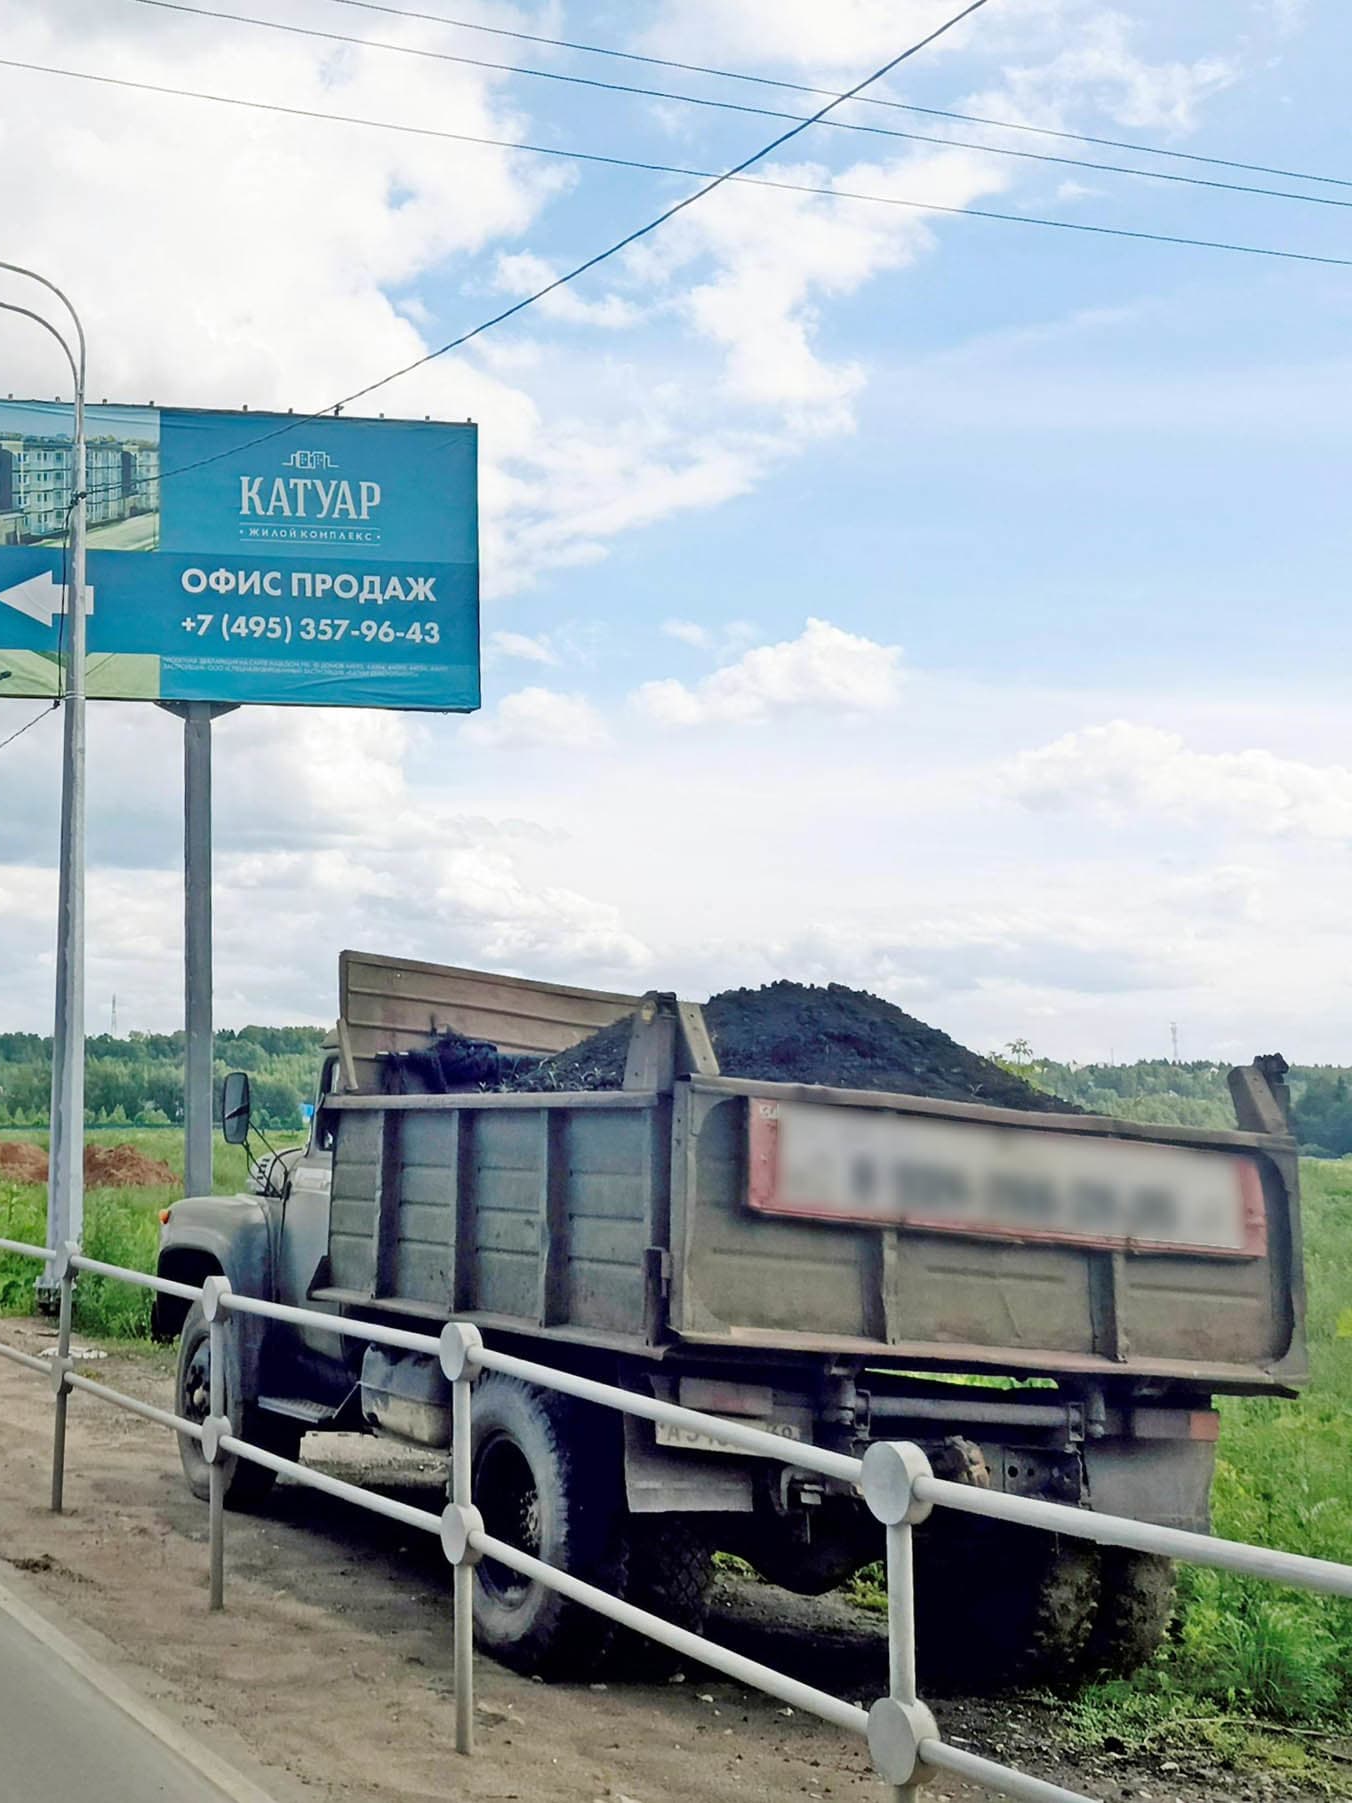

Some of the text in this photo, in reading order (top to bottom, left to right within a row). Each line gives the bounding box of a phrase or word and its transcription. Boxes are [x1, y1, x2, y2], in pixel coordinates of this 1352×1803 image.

[239, 475, 382, 520] КАТУАР
[248, 527, 373, 542] ЖИЛОЙ КОМПЛЕКС
[181, 567, 437, 605] ОФИС ПРОДАЖ
[181, 613, 441, 645] +7 (495) 357-96-43
